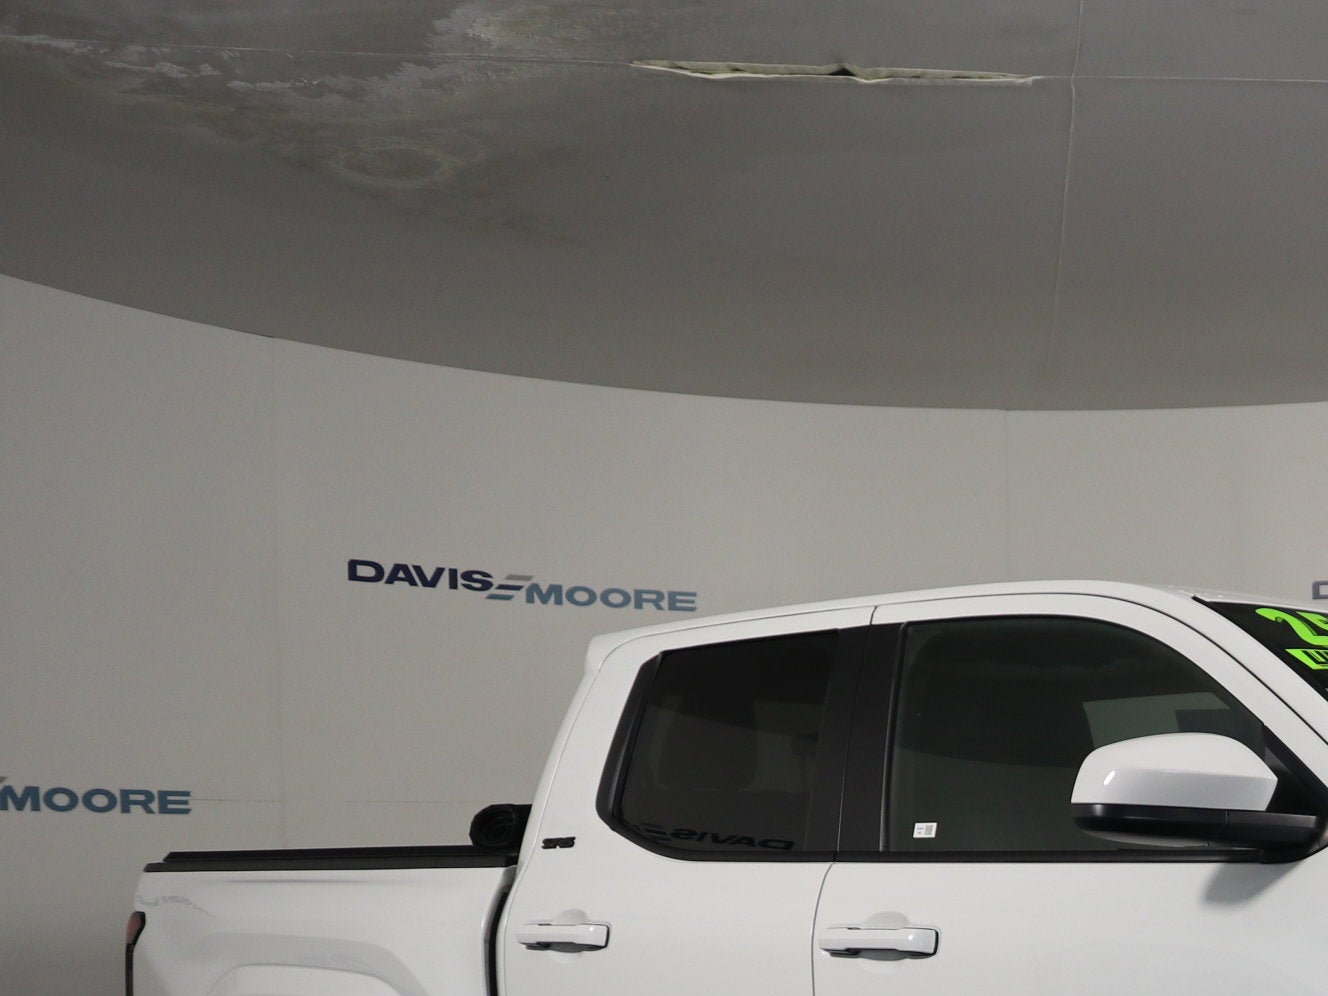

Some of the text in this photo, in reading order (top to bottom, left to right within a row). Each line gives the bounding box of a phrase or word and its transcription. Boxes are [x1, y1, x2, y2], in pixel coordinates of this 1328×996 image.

[348, 558, 697, 612] DAVIS MOORE
[0, 785, 192, 815] MOORE
